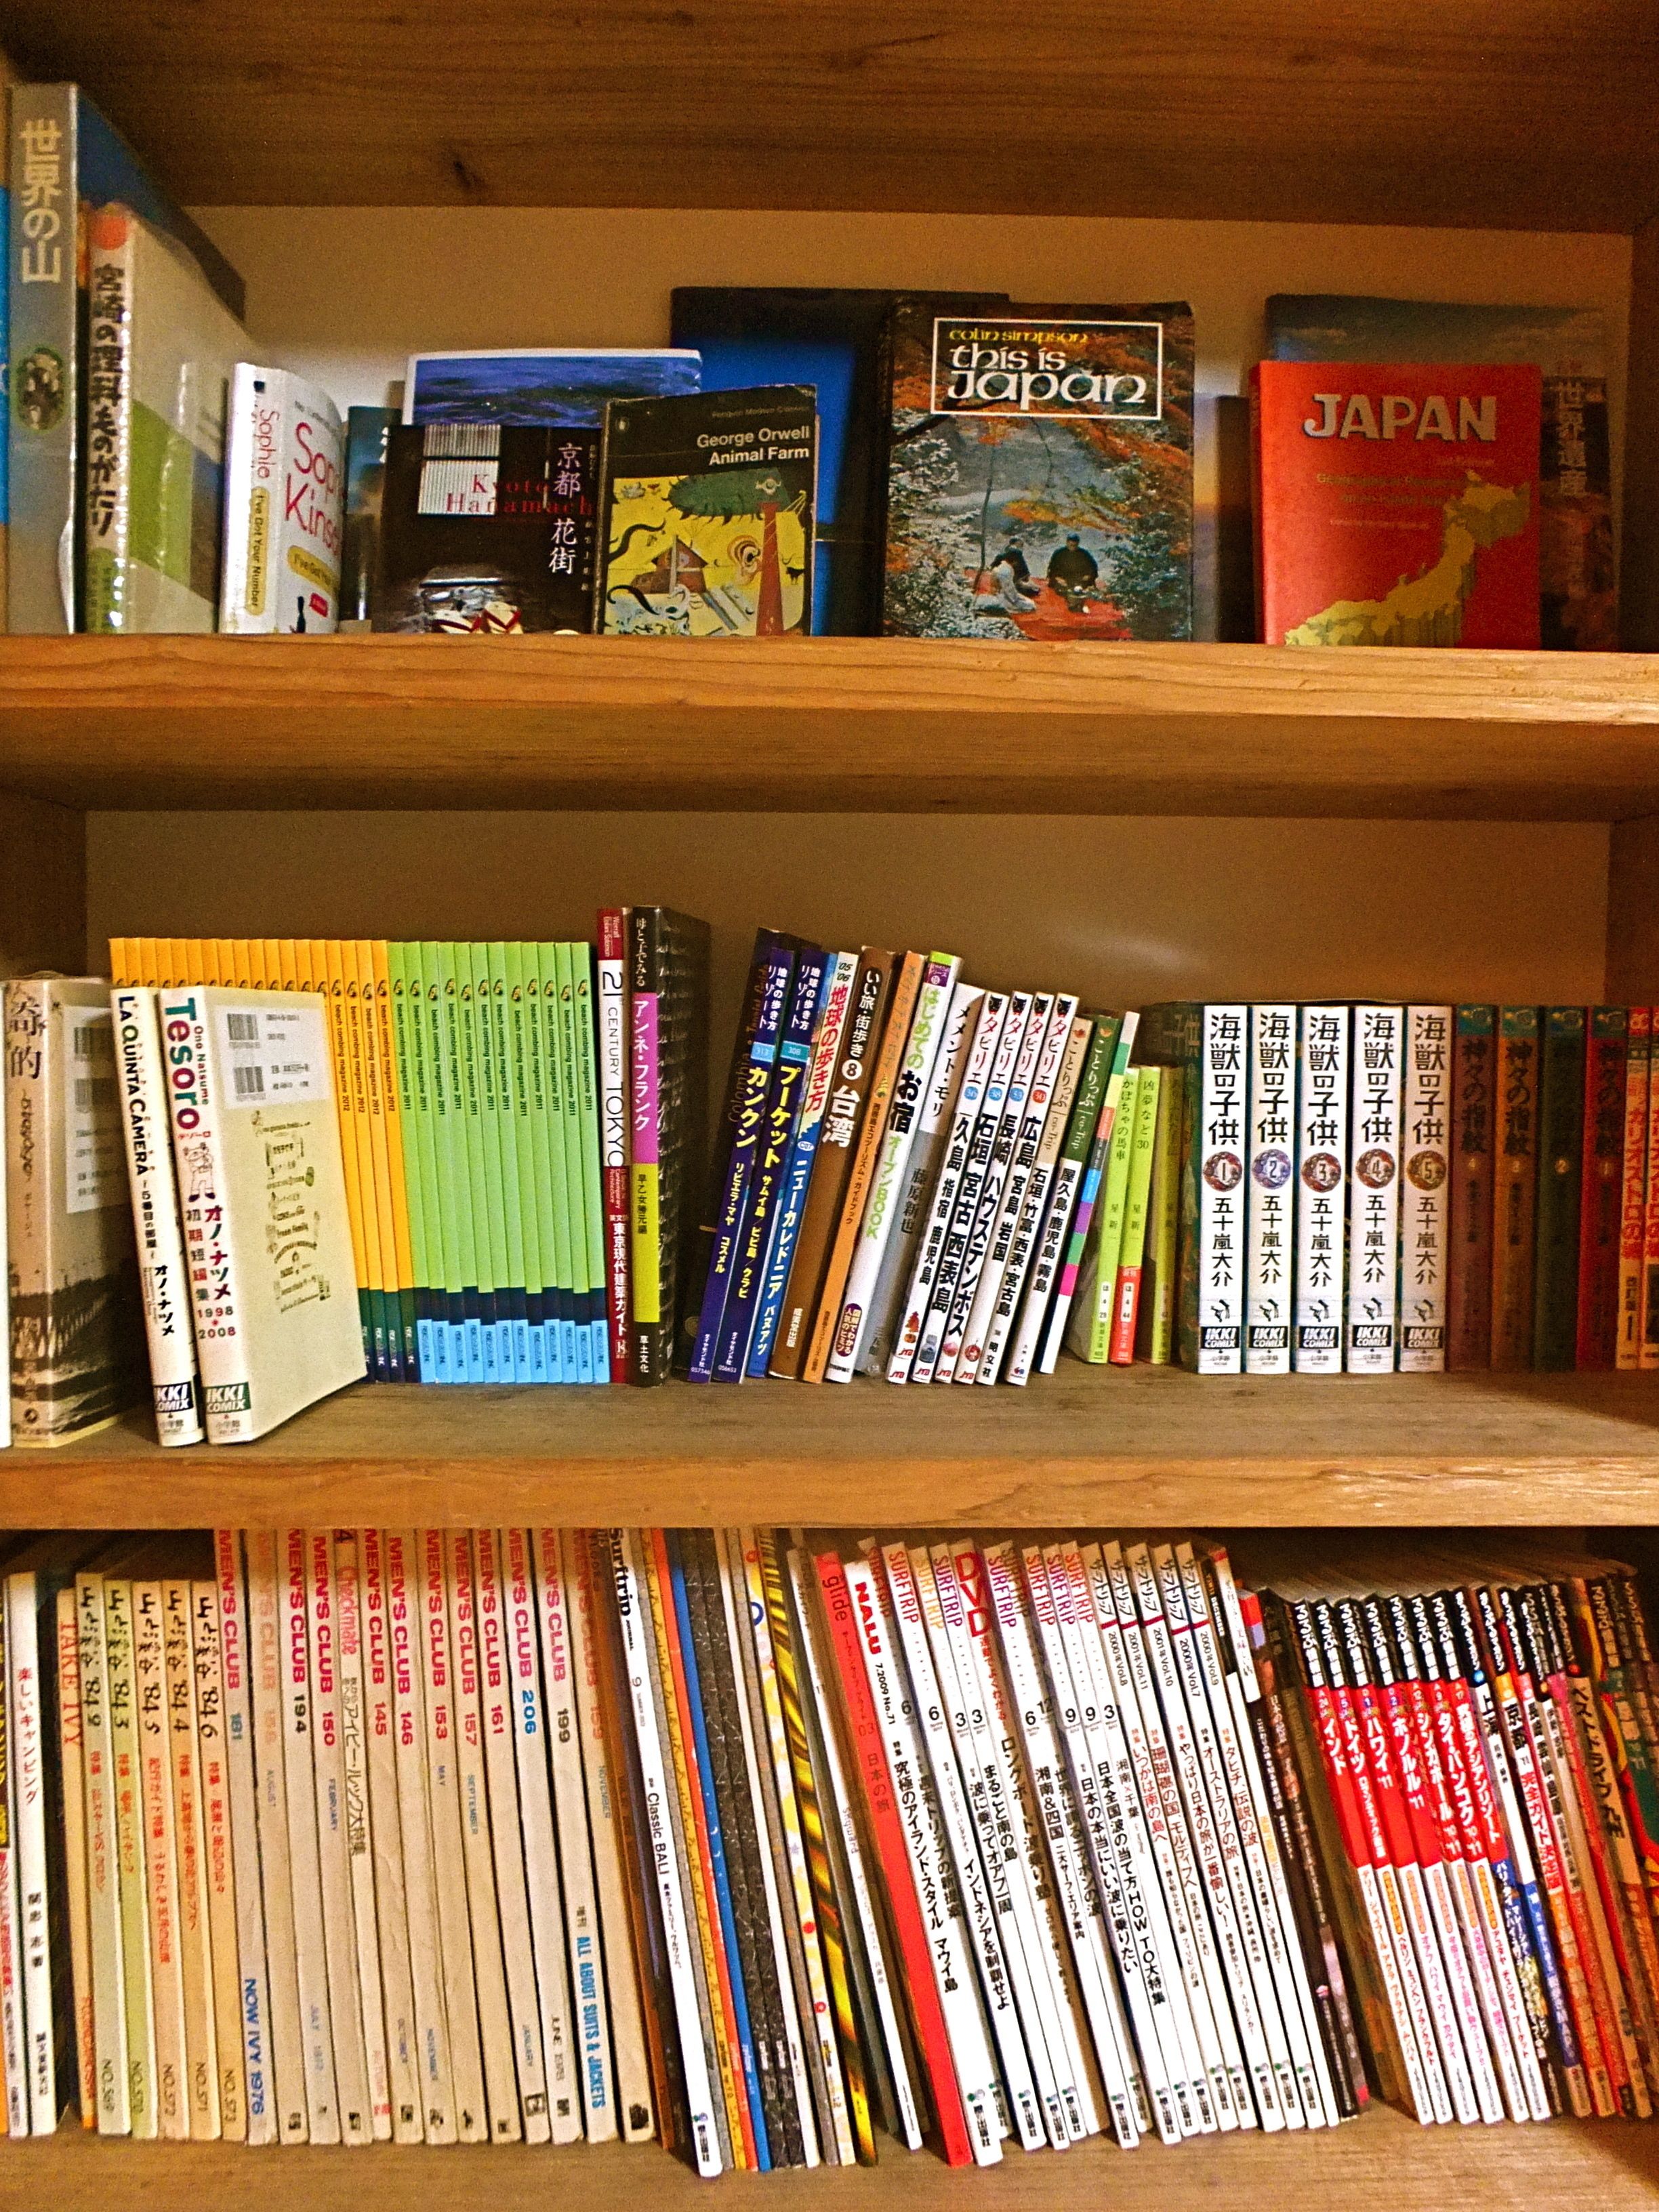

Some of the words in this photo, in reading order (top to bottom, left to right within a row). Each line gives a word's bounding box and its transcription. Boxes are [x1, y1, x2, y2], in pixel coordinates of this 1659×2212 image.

[20, 118, 62, 285] 世界の山
[949, 327, 1000, 342] colin
[1002, 329, 1088, 345] simpson
[949, 343, 1029, 370] this
[1038, 347, 1067, 371] is
[257, 409, 279, 479] Sophie
[696, 432, 754, 449] George
[758, 425, 810, 442] Orwell
[1303, 393, 1498, 442] JAPAN
[553, 443, 583, 499] 京都
[709, 447, 764, 466] Animal
[768, 446, 810, 460] Farm
[253, 538, 264, 563] Your
[548, 517, 577, 575] 花街
[251, 566, 262, 607] Number
[380, 1004, 388, 1027] beach
[530, 1004, 538, 1025] beach
[758, 964, 778, 1029] リゾート
[767, 966, 788, 1031] 地球の歩き方
[790, 964, 811, 1029] リゾート
[799, 966, 821, 1031] 地球の歩き方
[848, 969, 880, 1059] いい旅・街歩き
[121, 1025, 140, 1096] QUINTA
[164, 997, 201, 1130] Tesoro
[194, 1025, 204, 1049] Ono
[382, 1027, 390, 1059] combing
[531, 1026, 539, 1057] combing
[607, 1006, 621, 1076] CENTURY
[634, 1000, 651, 1131] アンネ・フランク
[805, 985, 848, 1113] 地球の歩き方
[933, 1006, 970, 1118] メメント・モリ
[967, 1016, 998, 1085] タビリエ
[991, 1017, 1023, 1086] タビリエ
[1013, 1018, 1044, 1086] タビリエ
[1036, 1019, 1067, 1088] タビリエ
[197, 1053, 209, 1105] Natsume
[383, 1059, 393, 1094] magazine
[387, 1095, 395, 1112] 2012
[532, 1058, 541, 1093] magazine
[535, 1094, 543, 1110] 2011
[888, 1069, 923, 1134] お宿
[1052, 1040, 1079, 1108] ことりっぷ
[1078, 1039, 1105, 1107] ことりっぷ
[1208, 1012, 1242, 1147] 海獣の子供
[1258, 1012, 1291, 1145] 海獣の子供
[1307, 1012, 1341, 1148] 海獣の子供
[1361, 1012, 1395, 1145] 海獣の子供
[1413, 1012, 1446, 1145] 海獣の子供
[129, 1099, 148, 1176] CAMERA
[606, 1081, 627, 1166] TOKYO
[736, 1067, 769, 1148] カンクン
[764, 1065, 801, 1168] プーケット
[822, 1084, 862, 1149] 台湾
[970, 1112, 998, 1166] 石垣
[991, 1113, 1019, 1167] 長崎
[1115, 1079, 1134, 1162] かぼちゃの馬車
[1015, 1115, 1043, 1169] 広島
[936, 1177, 956, 1219] 指宿
[955, 1172, 983, 1227] 宮古
[1004, 1174, 1027, 1216] 宮島
[204, 1204, 232, 1300] オノ・ナツメ
[715, 1236, 731, 1273] コスメル
[766, 1159, 808, 1300] ニューカレドニア
[919, 1225, 944, 1286] 鹿児島
[949, 1175, 1003, 1338] ハウステンボス
[991, 1221, 1013, 1263] 岩国
[1212, 1196, 1234, 1289] 五十嵐大介
[1259, 1193, 1284, 1285] 五十嵐大介
[1309, 1196, 1334, 1289] 五十嵐大介
[1363, 1193, 1388, 1284] 五十嵐大介
[1415, 1195, 1439, 1286] 五十嵐大介
[155, 1265, 175, 1336] オノ・ナツメ
[737, 1267, 753, 1299] クラビ
[931, 1231, 968, 1315] 西表島
[197, 1305, 234, 1319] 1998
[198, 1326, 236, 1339] 2008
[756, 1304, 777, 1356] バヌアツ
[1204, 1328, 1236, 1341] IKKI
[1357, 1327, 1391, 1340] IKKI
[899, 1347, 915, 1356] JTB
[915, 1368, 931, 1376] JTB
[205, 1384, 245, 1404] IKKI
[822, 1574, 847, 1622] glide
[854, 1581, 882, 1656] NALU
[888, 1550, 919, 1624] SURFTRIP
[933, 1553, 963, 1627] SURFTRIP
[954, 1551, 990, 1638] DVD
[987, 1555, 1017, 1629] SURFTRIP
[1025, 1555, 1057, 1626] SURFTRIP
[60, 1620, 80, 1691] TAKE
[317, 1625, 332, 1694] CLUB
[393, 1626, 411, 1694] CLUB
[459, 1625, 476, 1694] CLUB
[515, 1609, 533, 1678] CLUB
[63, 1702, 83, 1747] IVY
[323, 1711, 335, 1746] 150
[401, 1711, 413, 1746] 146
[464, 1713, 478, 1746] 157
[522, 1689, 537, 1735] 206
[1324, 1717, 1347, 1776] インド
[1344, 1717, 1367, 1774] ドイツ
[1367, 1717, 1389, 1773] ハワイ
[1391, 1717, 1422, 1793] ホノルル
[1416, 1713, 1454, 1822] シンガポール
[1437, 1712, 1475, 1826] タイ・バンコク
[647, 1793, 663, 1839] Classic
[1133, 1746, 1168, 1842] いつかは南の島へ
[1203, 1746, 1240, 1860] オーストラリアの旅
[654, 1843, 670, 1875] BALI
[1080, 1778, 1139, 1974] 日本の本当にいい波に乗りたい
[576, 1936, 593, 1959] ALL
[933, 1937, 959, 1994] マウイ島
[245, 1978, 260, 2026] NOW
[579, 1961, 597, 2001] ABOUT
[249, 2029, 264, 2065] IVY
[583, 2004, 600, 2041] SUITS
[250, 2069, 266, 2117] 1976
[588, 2055, 606, 2111] JACKETS
